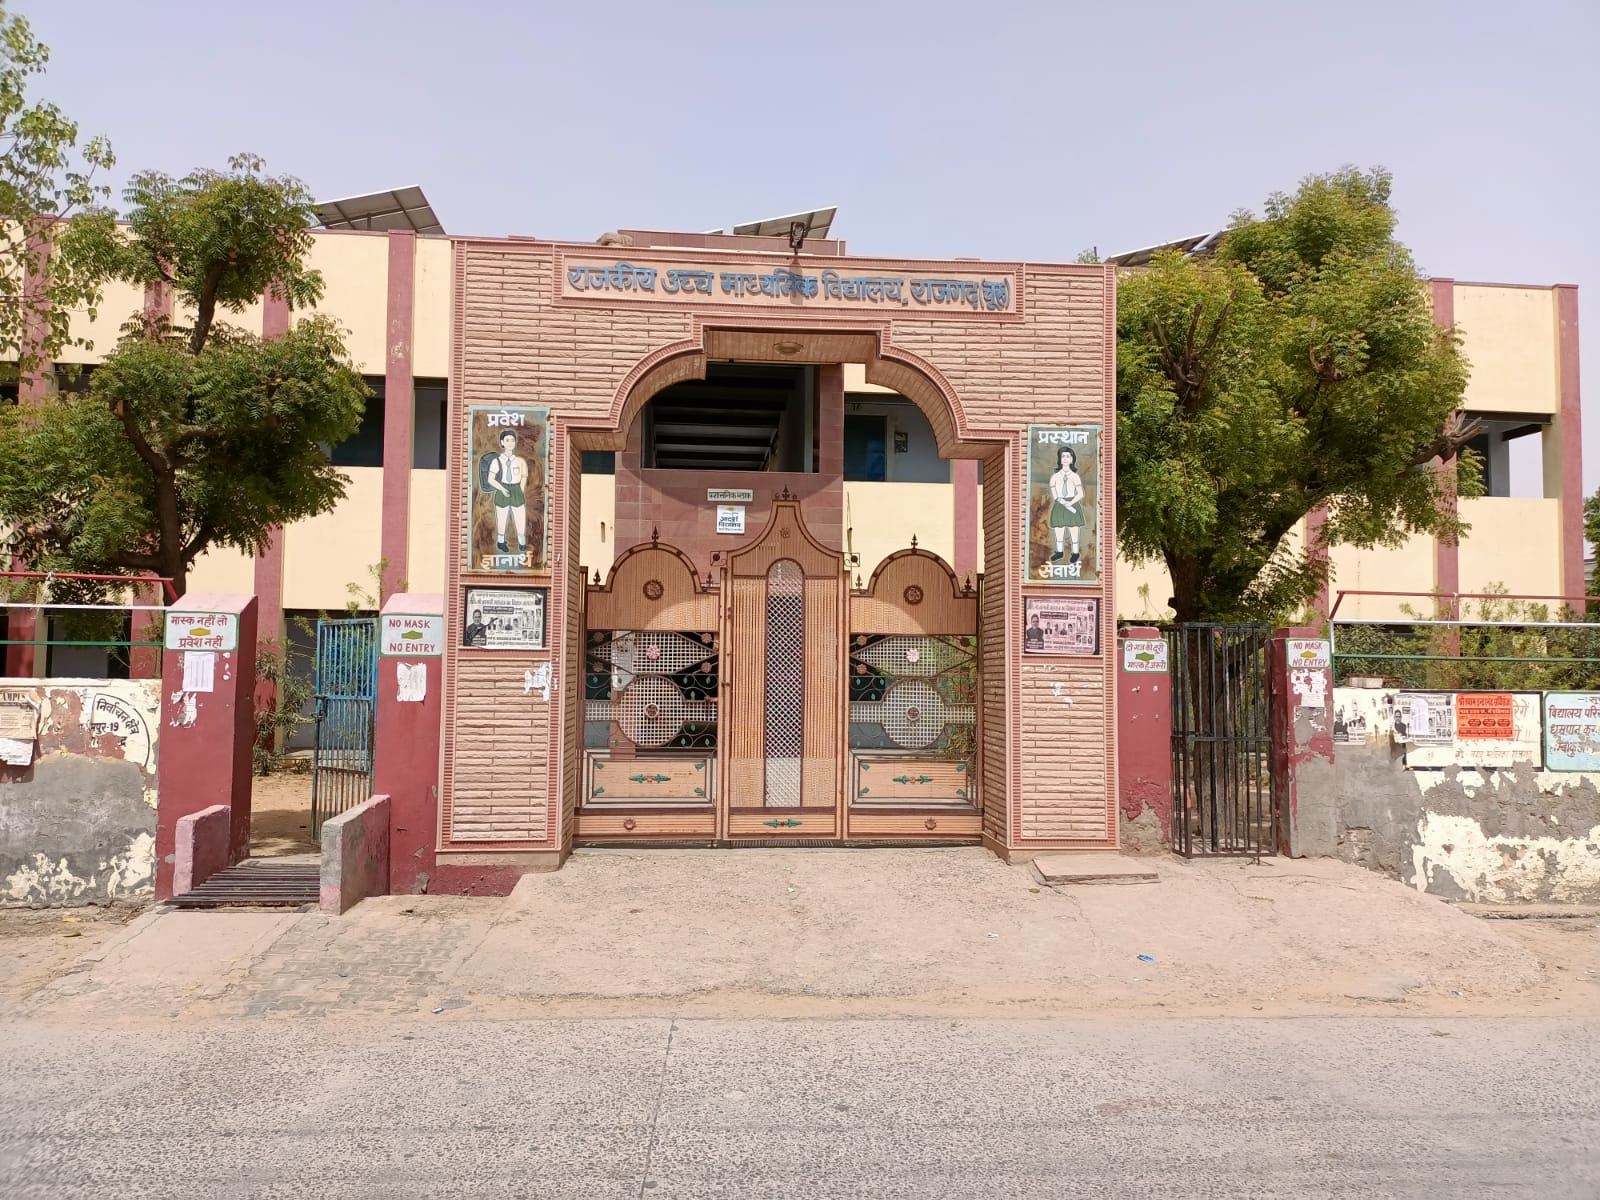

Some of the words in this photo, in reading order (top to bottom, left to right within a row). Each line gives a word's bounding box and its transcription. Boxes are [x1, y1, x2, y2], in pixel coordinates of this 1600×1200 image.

[567, 261, 657, 292] राजकीय
[662, 269, 714, 296] उच्च
[720, 268, 818, 299] माध्यमिक
[486, 411, 525, 427] प्रवेश
[1038, 431, 1089, 445] प्रस्थान
[480, 550, 534, 570] ज्ञानार्थ
[1038, 561, 1082, 578] सेवार्थ
[171, 616, 195, 625] मास्क
[197, 614, 216, 627] नहीं
[217, 615, 228, 626] तो
[389, 619, 401, 628] NO
[404, 619, 430, 628] MASK
[178, 636, 202, 648] प्रवेश
[204, 635, 224, 648] नहीं
[389, 643, 403, 652] NO
[405, 643, 435, 653] ENTRY
[96, 698, 131, 723] निर्वाचन
[1548, 705, 1583, 718] विद्यालय
[1584, 705, 1600, 718] परि
